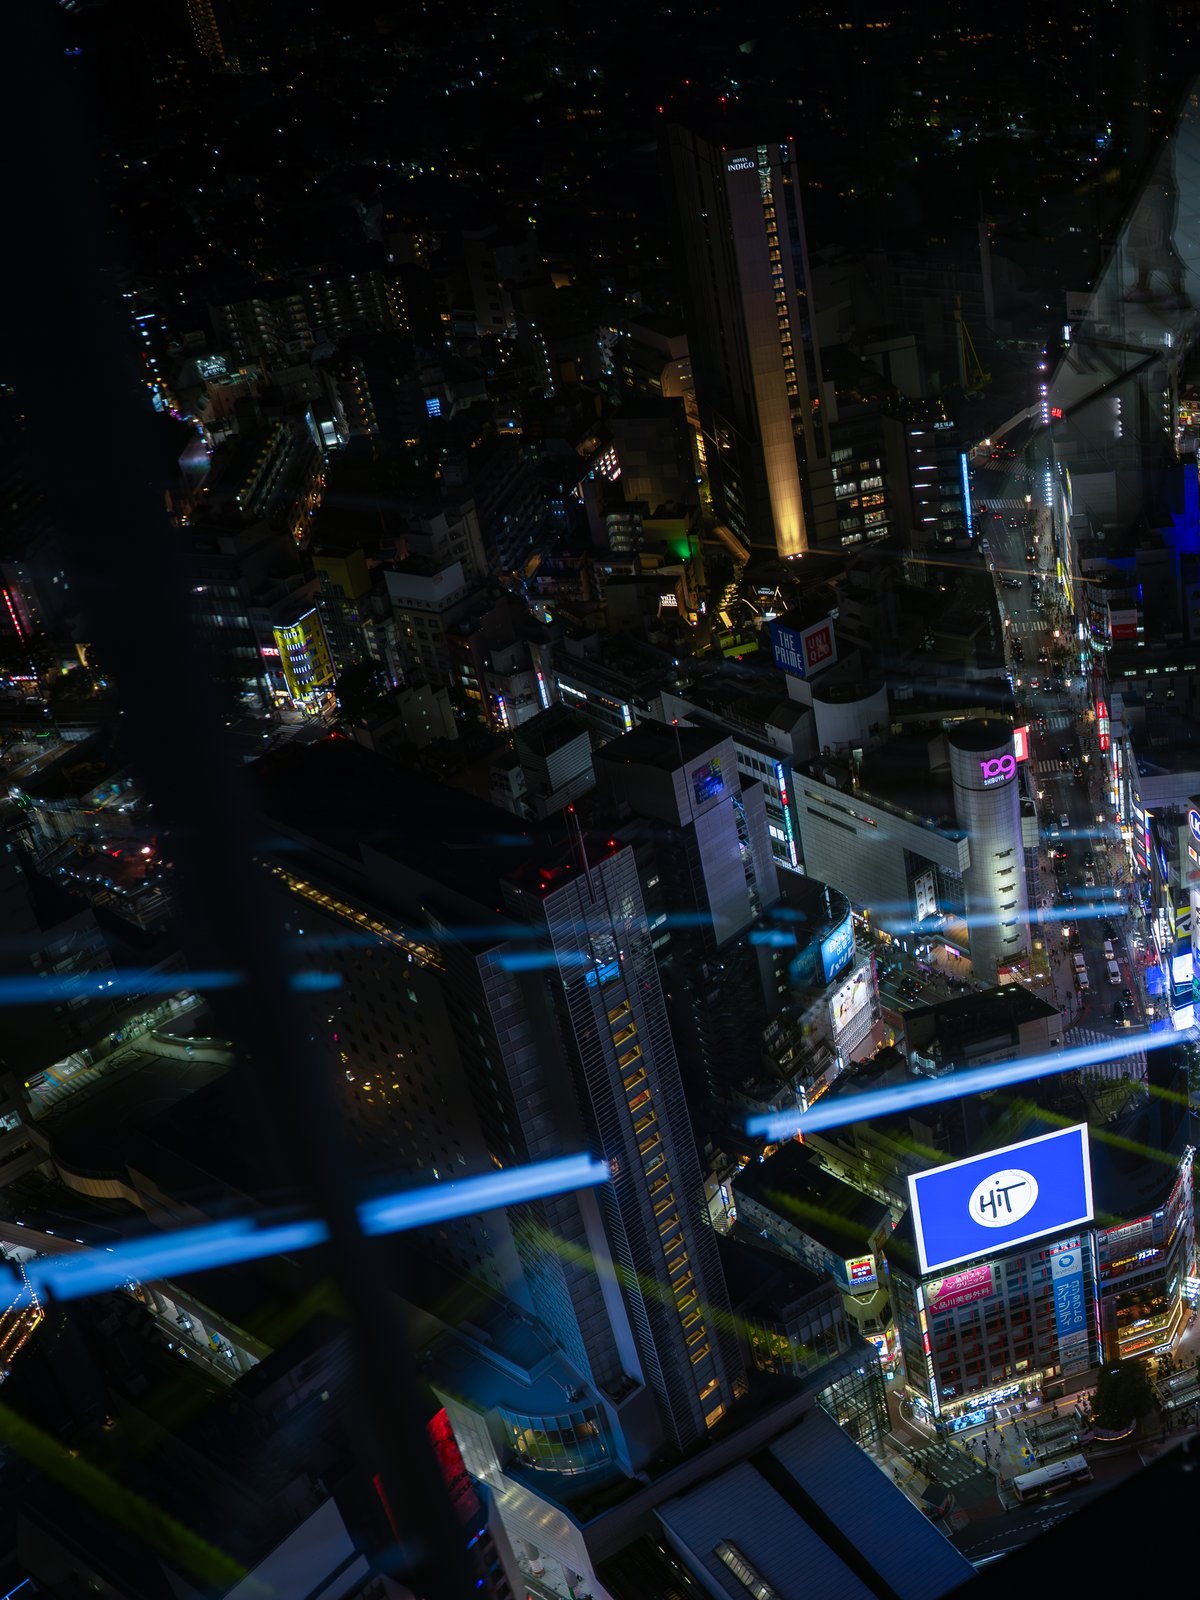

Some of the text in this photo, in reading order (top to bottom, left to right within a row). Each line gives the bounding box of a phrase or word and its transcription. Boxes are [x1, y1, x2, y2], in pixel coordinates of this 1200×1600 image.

[727, 161, 756, 172] INDIGO
[777, 630, 796, 652] THE
[808, 631, 827, 649] UNI
[774, 645, 804, 671] PRIME
[810, 643, 831, 662] QLO
[980, 754, 1017, 780] 109
[983, 774, 1005, 786] SHIBUYA
[1138, 1248, 1160, 1261] ガスト
[955, 1269, 988, 1284] 品川スキン
[956, 1275, 985, 1289] クリニック
[938, 1287, 991, 1310] 品川美容外科
[969, 1385, 1020, 1409] サンドラッグ
